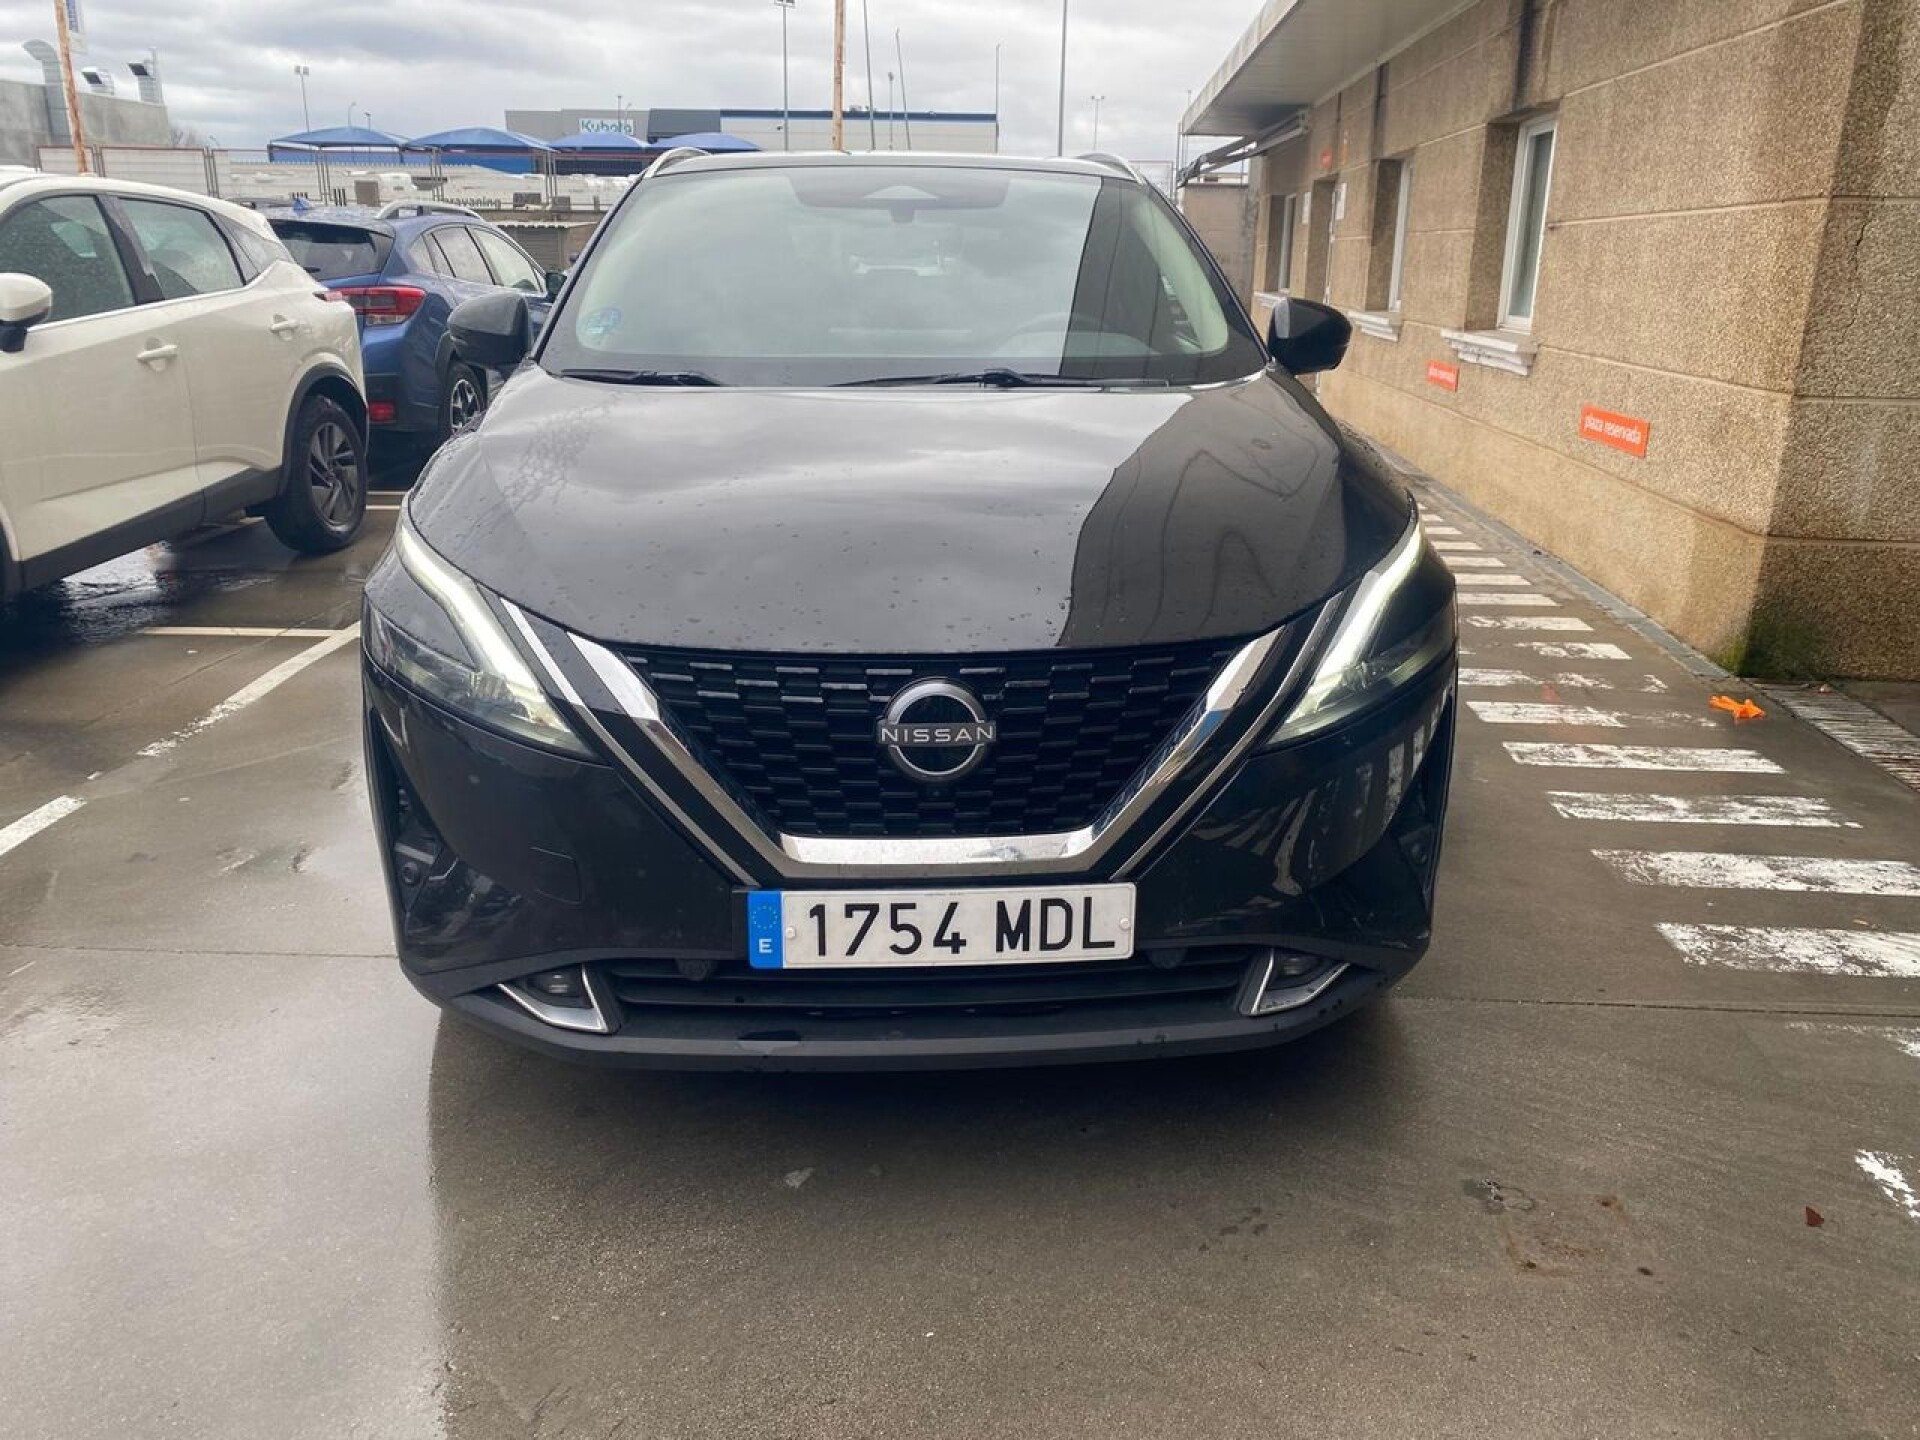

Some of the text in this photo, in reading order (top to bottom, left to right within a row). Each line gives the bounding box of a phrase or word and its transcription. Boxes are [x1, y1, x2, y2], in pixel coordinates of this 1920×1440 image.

[581, 119, 633, 133] Kubota
[881, 725, 994, 742] NISSAN
[809, 896, 1115, 957] 1754 MDL
[758, 938, 772, 954] E
